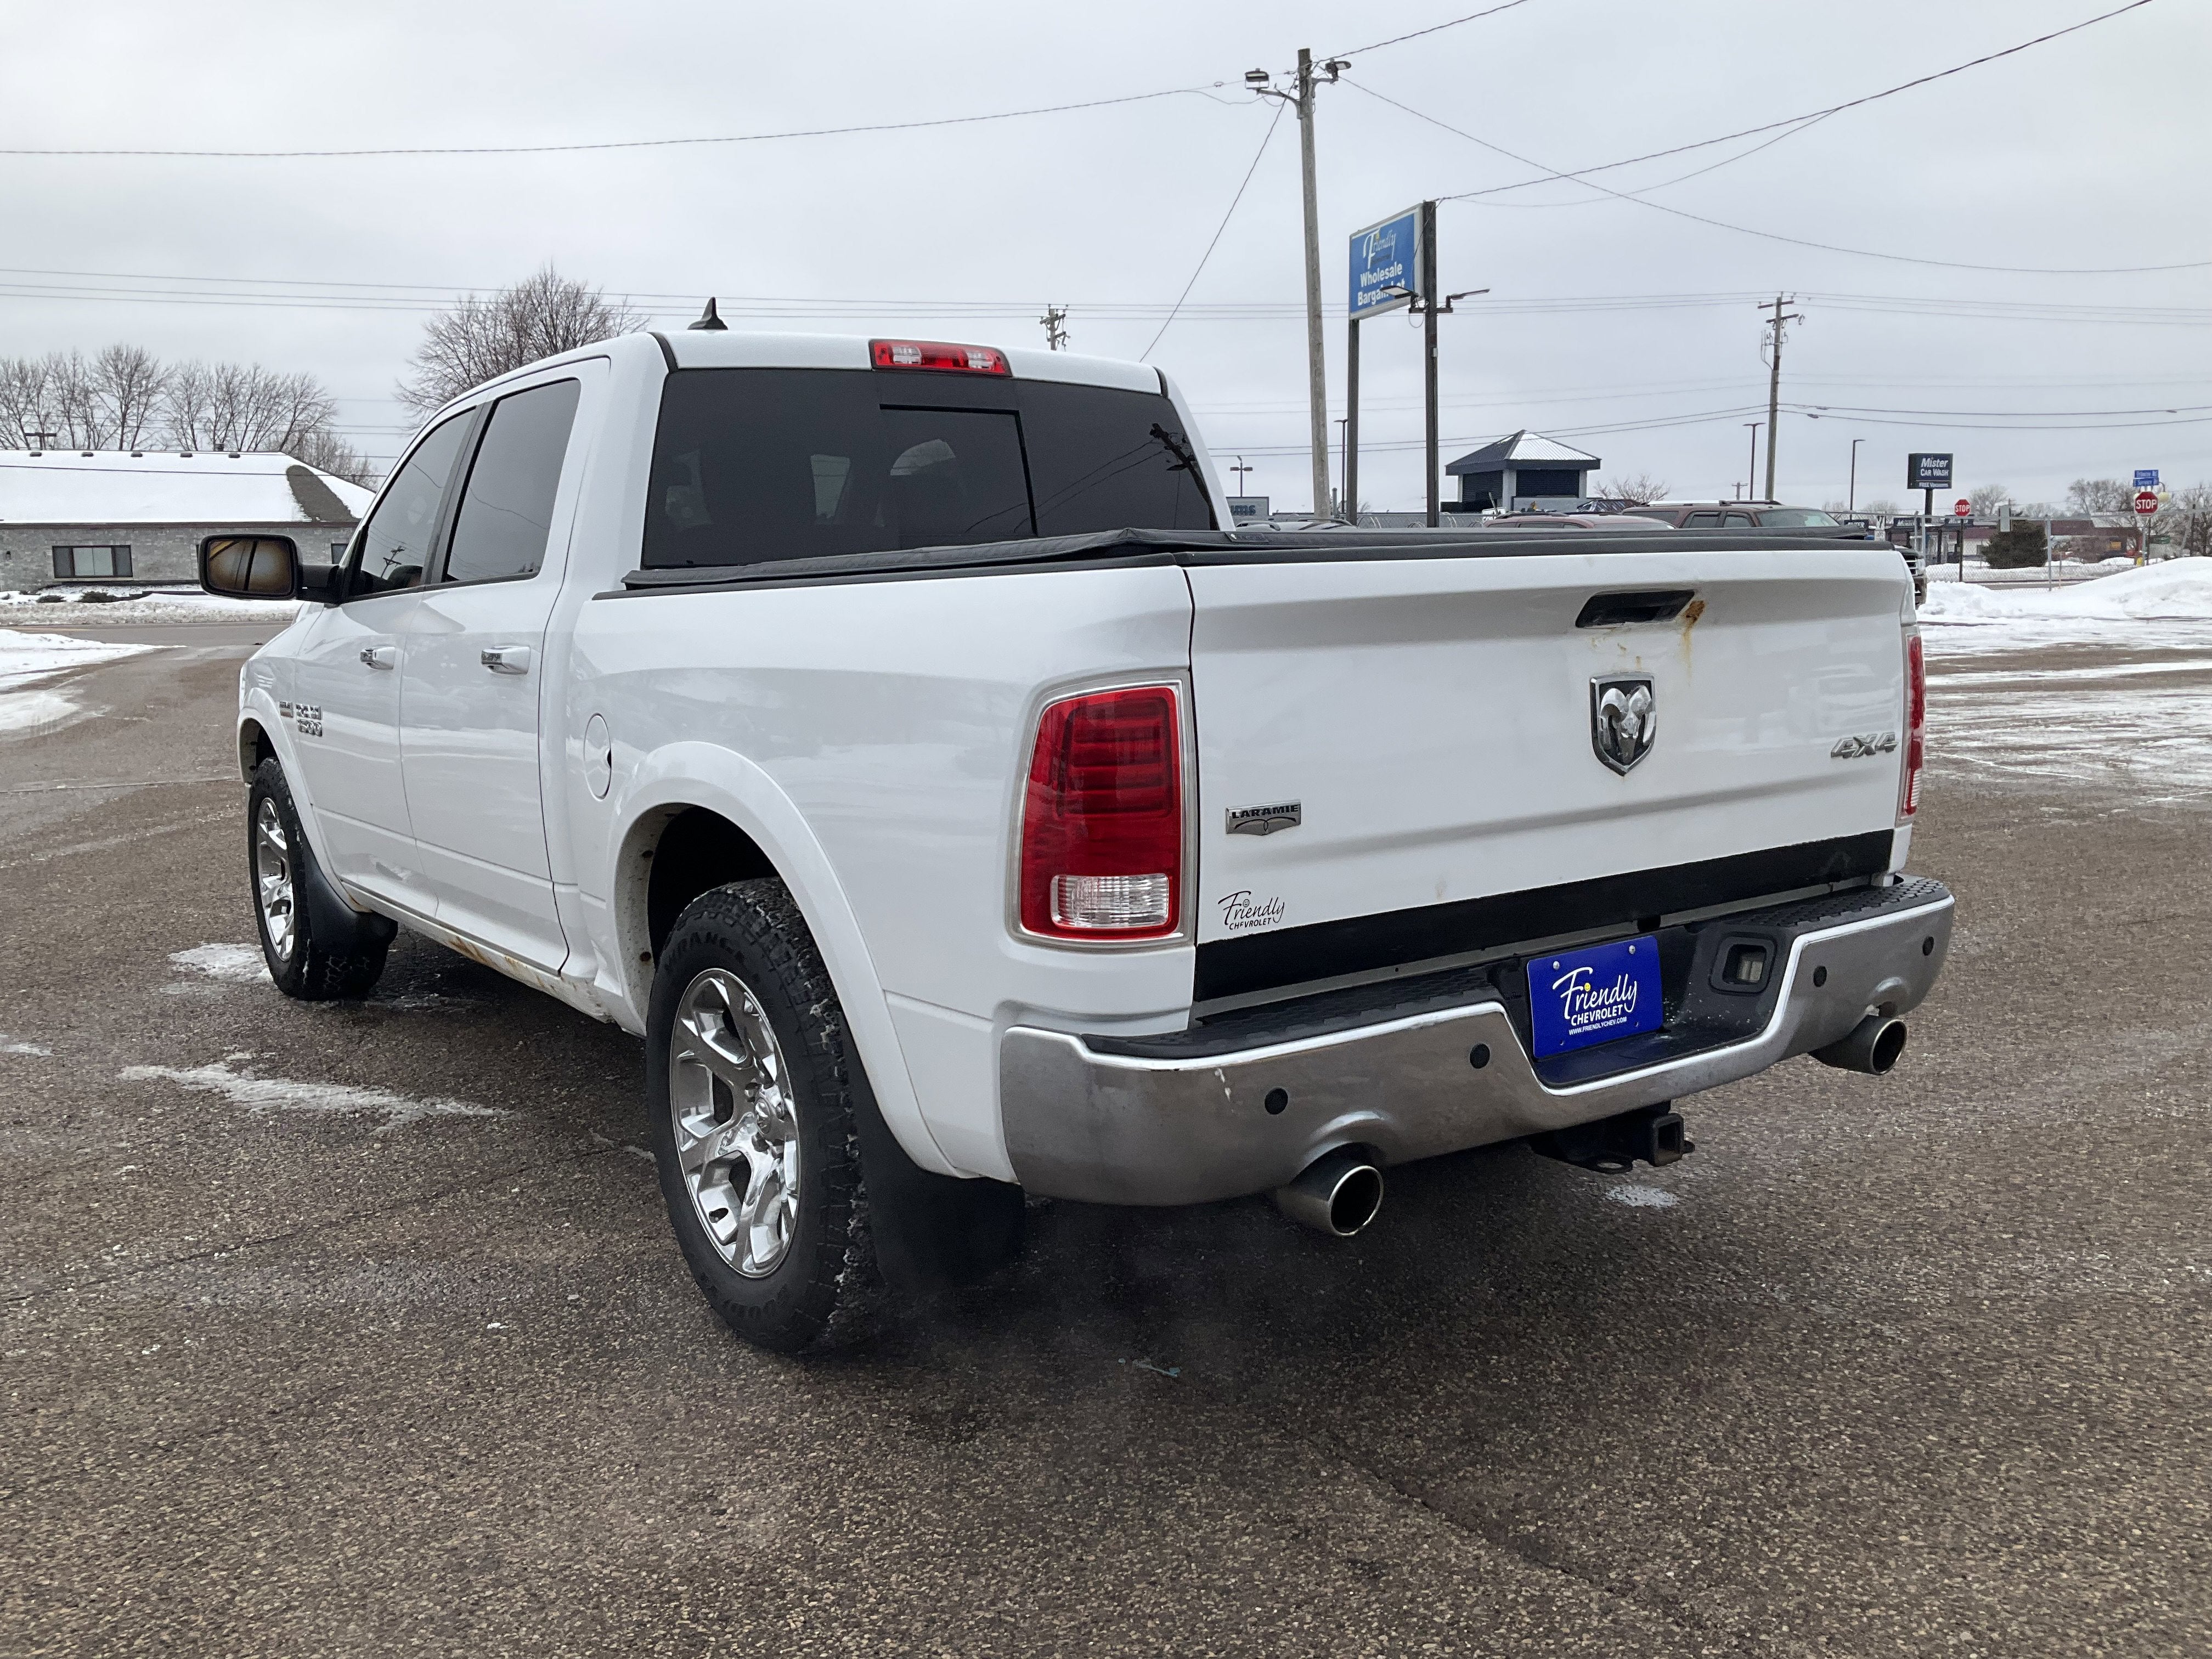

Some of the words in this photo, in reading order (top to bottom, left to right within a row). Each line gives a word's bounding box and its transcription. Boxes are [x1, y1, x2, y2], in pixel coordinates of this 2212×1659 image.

[1363, 228, 1396, 269] Friendly
[1360, 262, 1402, 287] Wholesale
[1921, 457, 1949, 467] Mister
[1932, 468, 1949, 476] WASH
[1955, 504, 1970, 512] STOP
[2136, 499, 2157, 510] STOP
[1232, 804, 1299, 819] LARAMIE
[1218, 890, 1285, 926] Friendly
[1229, 917, 1272, 930] CHEVROLET
[1552, 967, 1638, 1020] Friendly
[1571, 1004, 1623, 1026] CHEVROLET
[1568, 1016, 1628, 1036] WWW.FRIENDLYCHEV.COM
